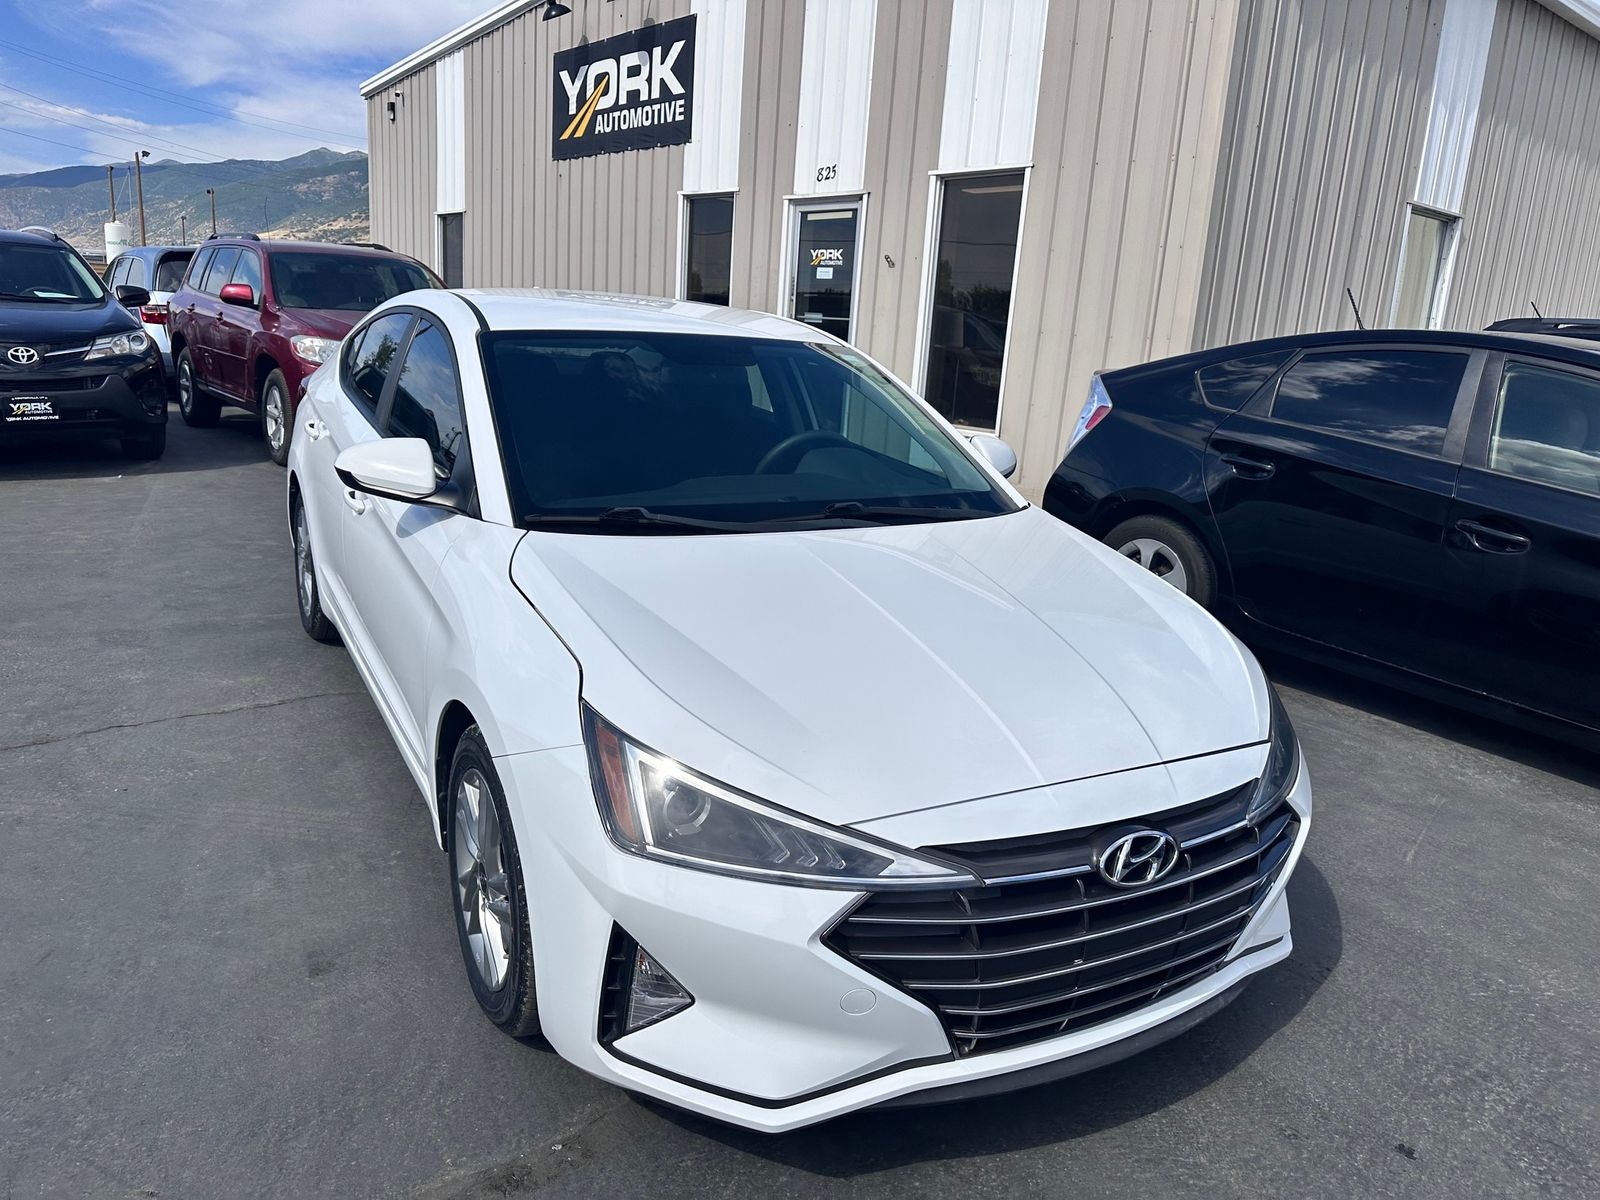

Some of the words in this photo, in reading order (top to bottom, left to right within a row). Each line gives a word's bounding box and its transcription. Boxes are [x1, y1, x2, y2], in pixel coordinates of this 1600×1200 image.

[559, 40, 686, 115] YORK
[594, 99, 685, 134] AUTOMOTIVE
[816, 164, 837, 182] 825
[810, 249, 843, 260] YORK
[9, 402, 52, 411] YORK
